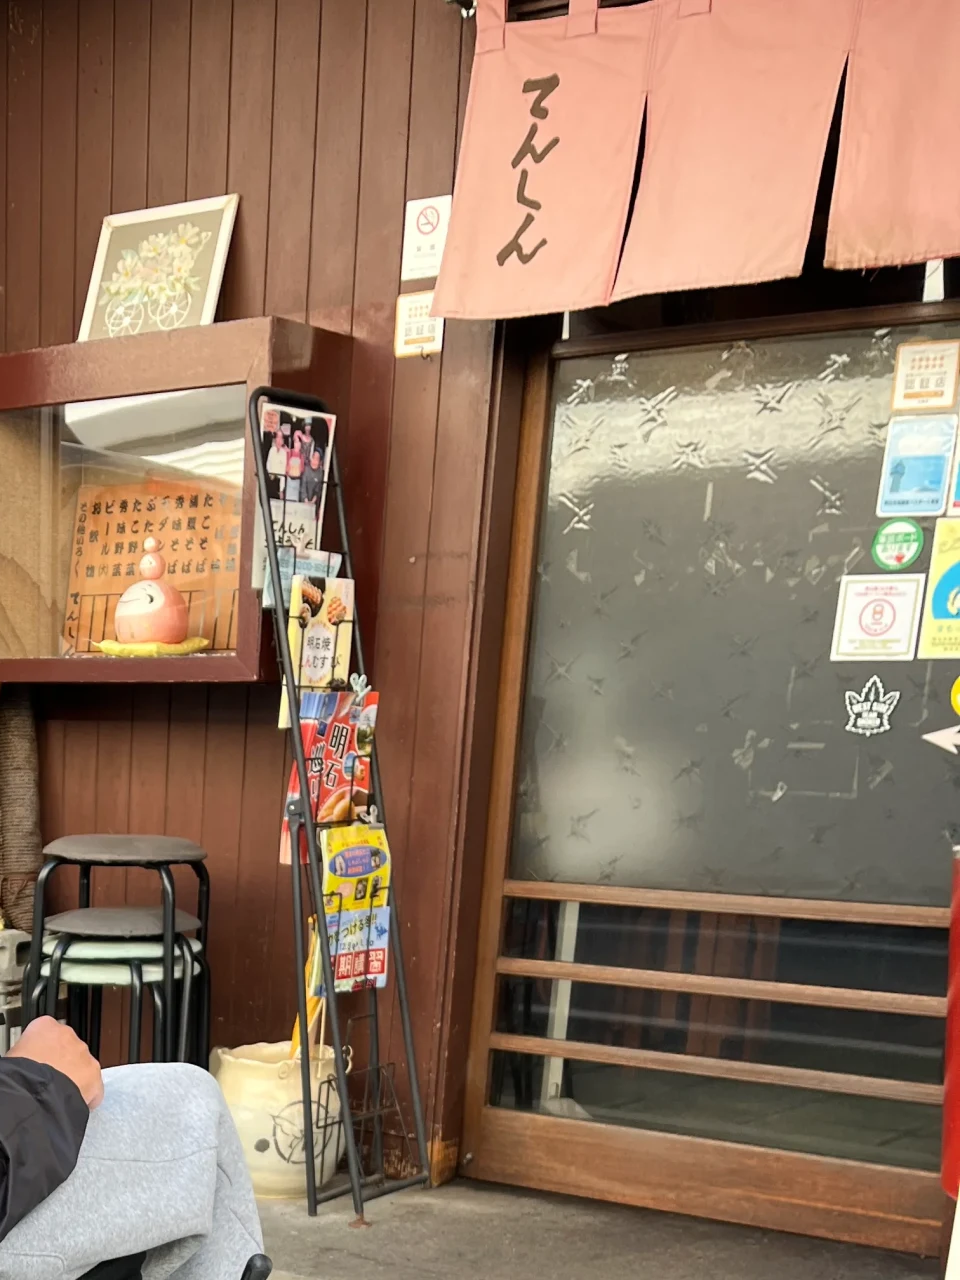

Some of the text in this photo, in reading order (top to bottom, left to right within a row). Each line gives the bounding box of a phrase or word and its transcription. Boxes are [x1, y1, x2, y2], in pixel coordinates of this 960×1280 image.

[496, 72, 561, 267] てんしん
[307, 636, 331, 651] 明石焼
[324, 722, 351, 789] 明石
[331, 950, 384, 979] 期講習
